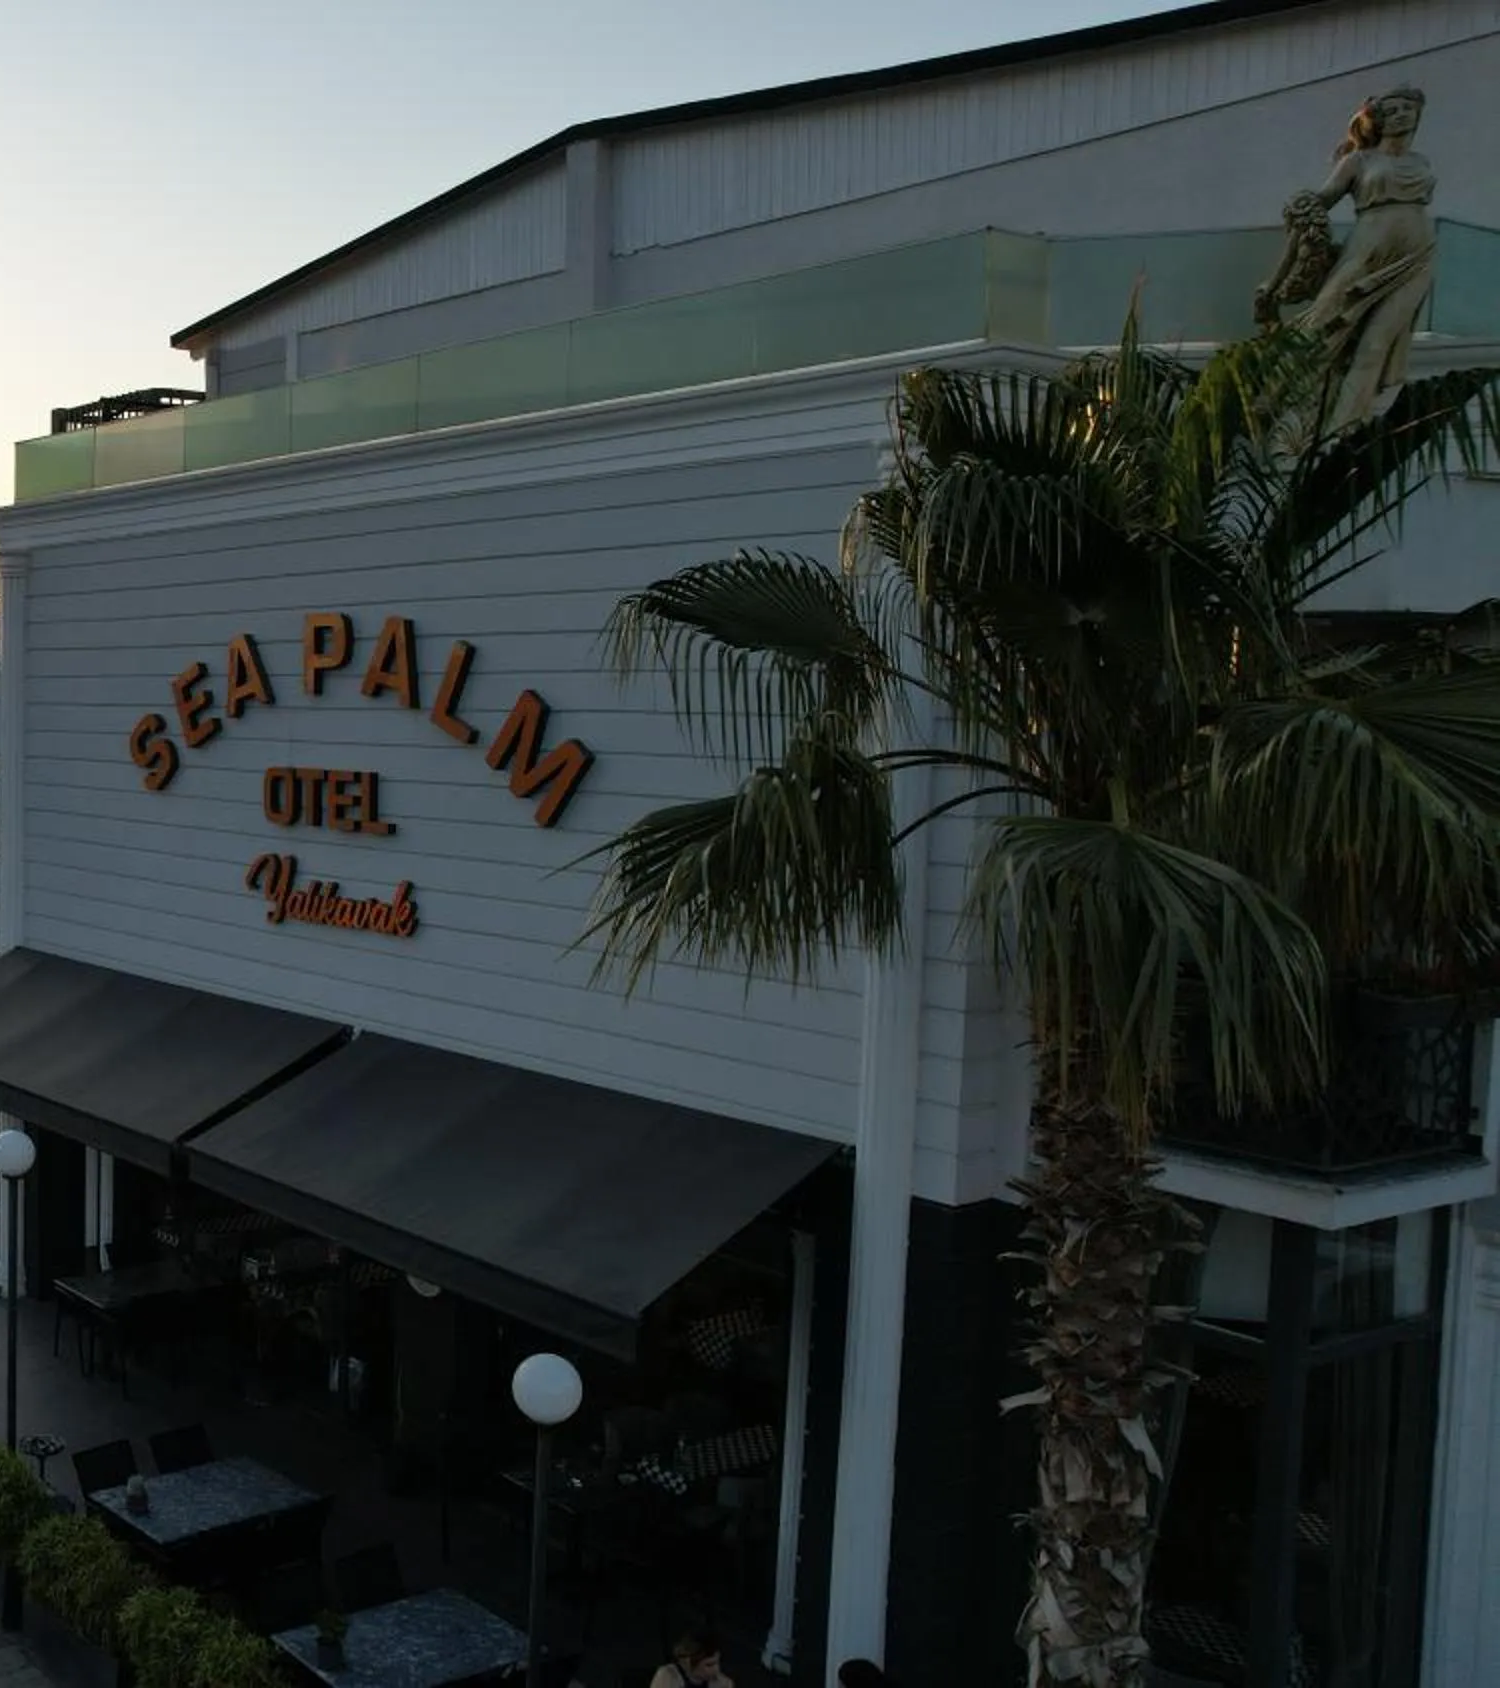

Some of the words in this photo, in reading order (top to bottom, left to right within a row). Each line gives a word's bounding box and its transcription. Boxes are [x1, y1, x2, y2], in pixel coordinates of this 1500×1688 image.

[129, 632, 276, 791] SEA
[303, 611, 596, 828] PALM
[263, 766, 397, 836] OTEL
